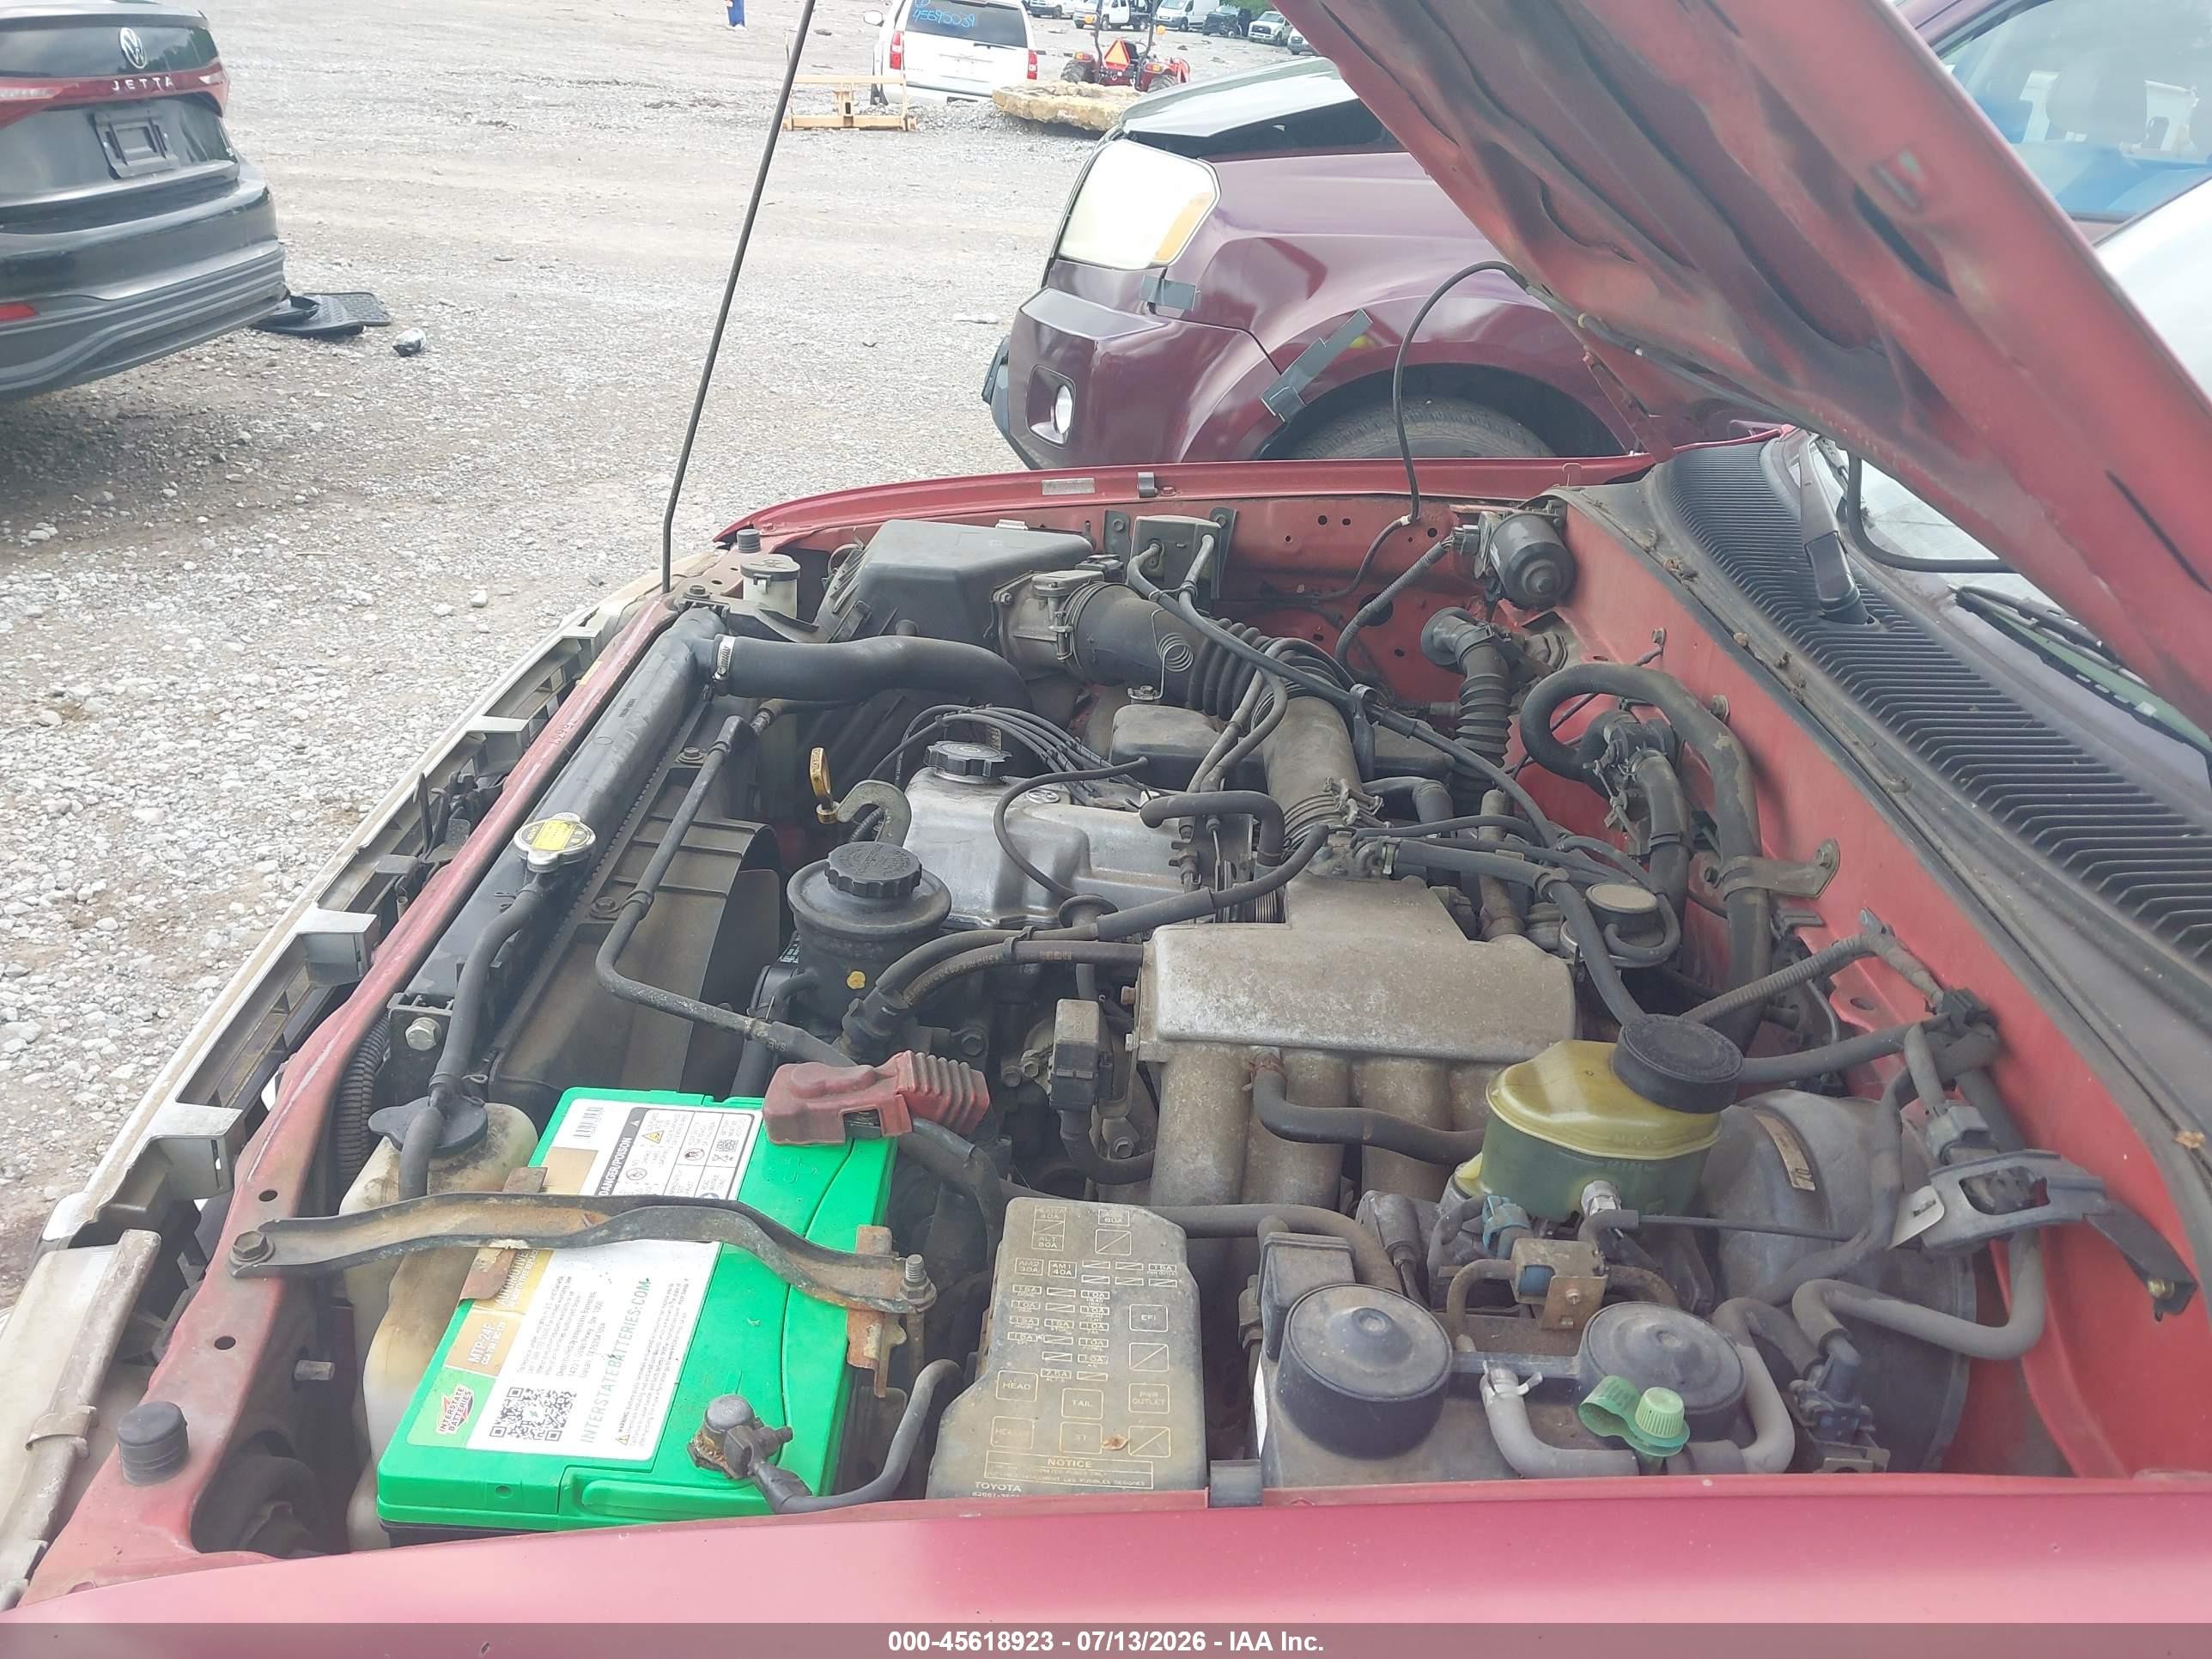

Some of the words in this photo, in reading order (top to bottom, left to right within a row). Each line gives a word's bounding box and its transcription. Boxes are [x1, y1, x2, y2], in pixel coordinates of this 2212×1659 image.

[112, 76, 174, 92] JETTA
[599, 1137, 633, 1195] DANGER/POISON
[495, 1251, 530, 1305] AUTOMOTIVE
[1002, 1381, 1031, 1391] HEAD
[1071, 1399, 1093, 1408] TAIL
[1132, 1397, 1165, 1407] OUTLET
[439, 1386, 465, 1432] INTERSTATE
[448, 1389, 473, 1431] BATTERIES
[1047, 1457, 1093, 1468] NOTICE
[975, 1481, 1023, 1492] TOYOTA
